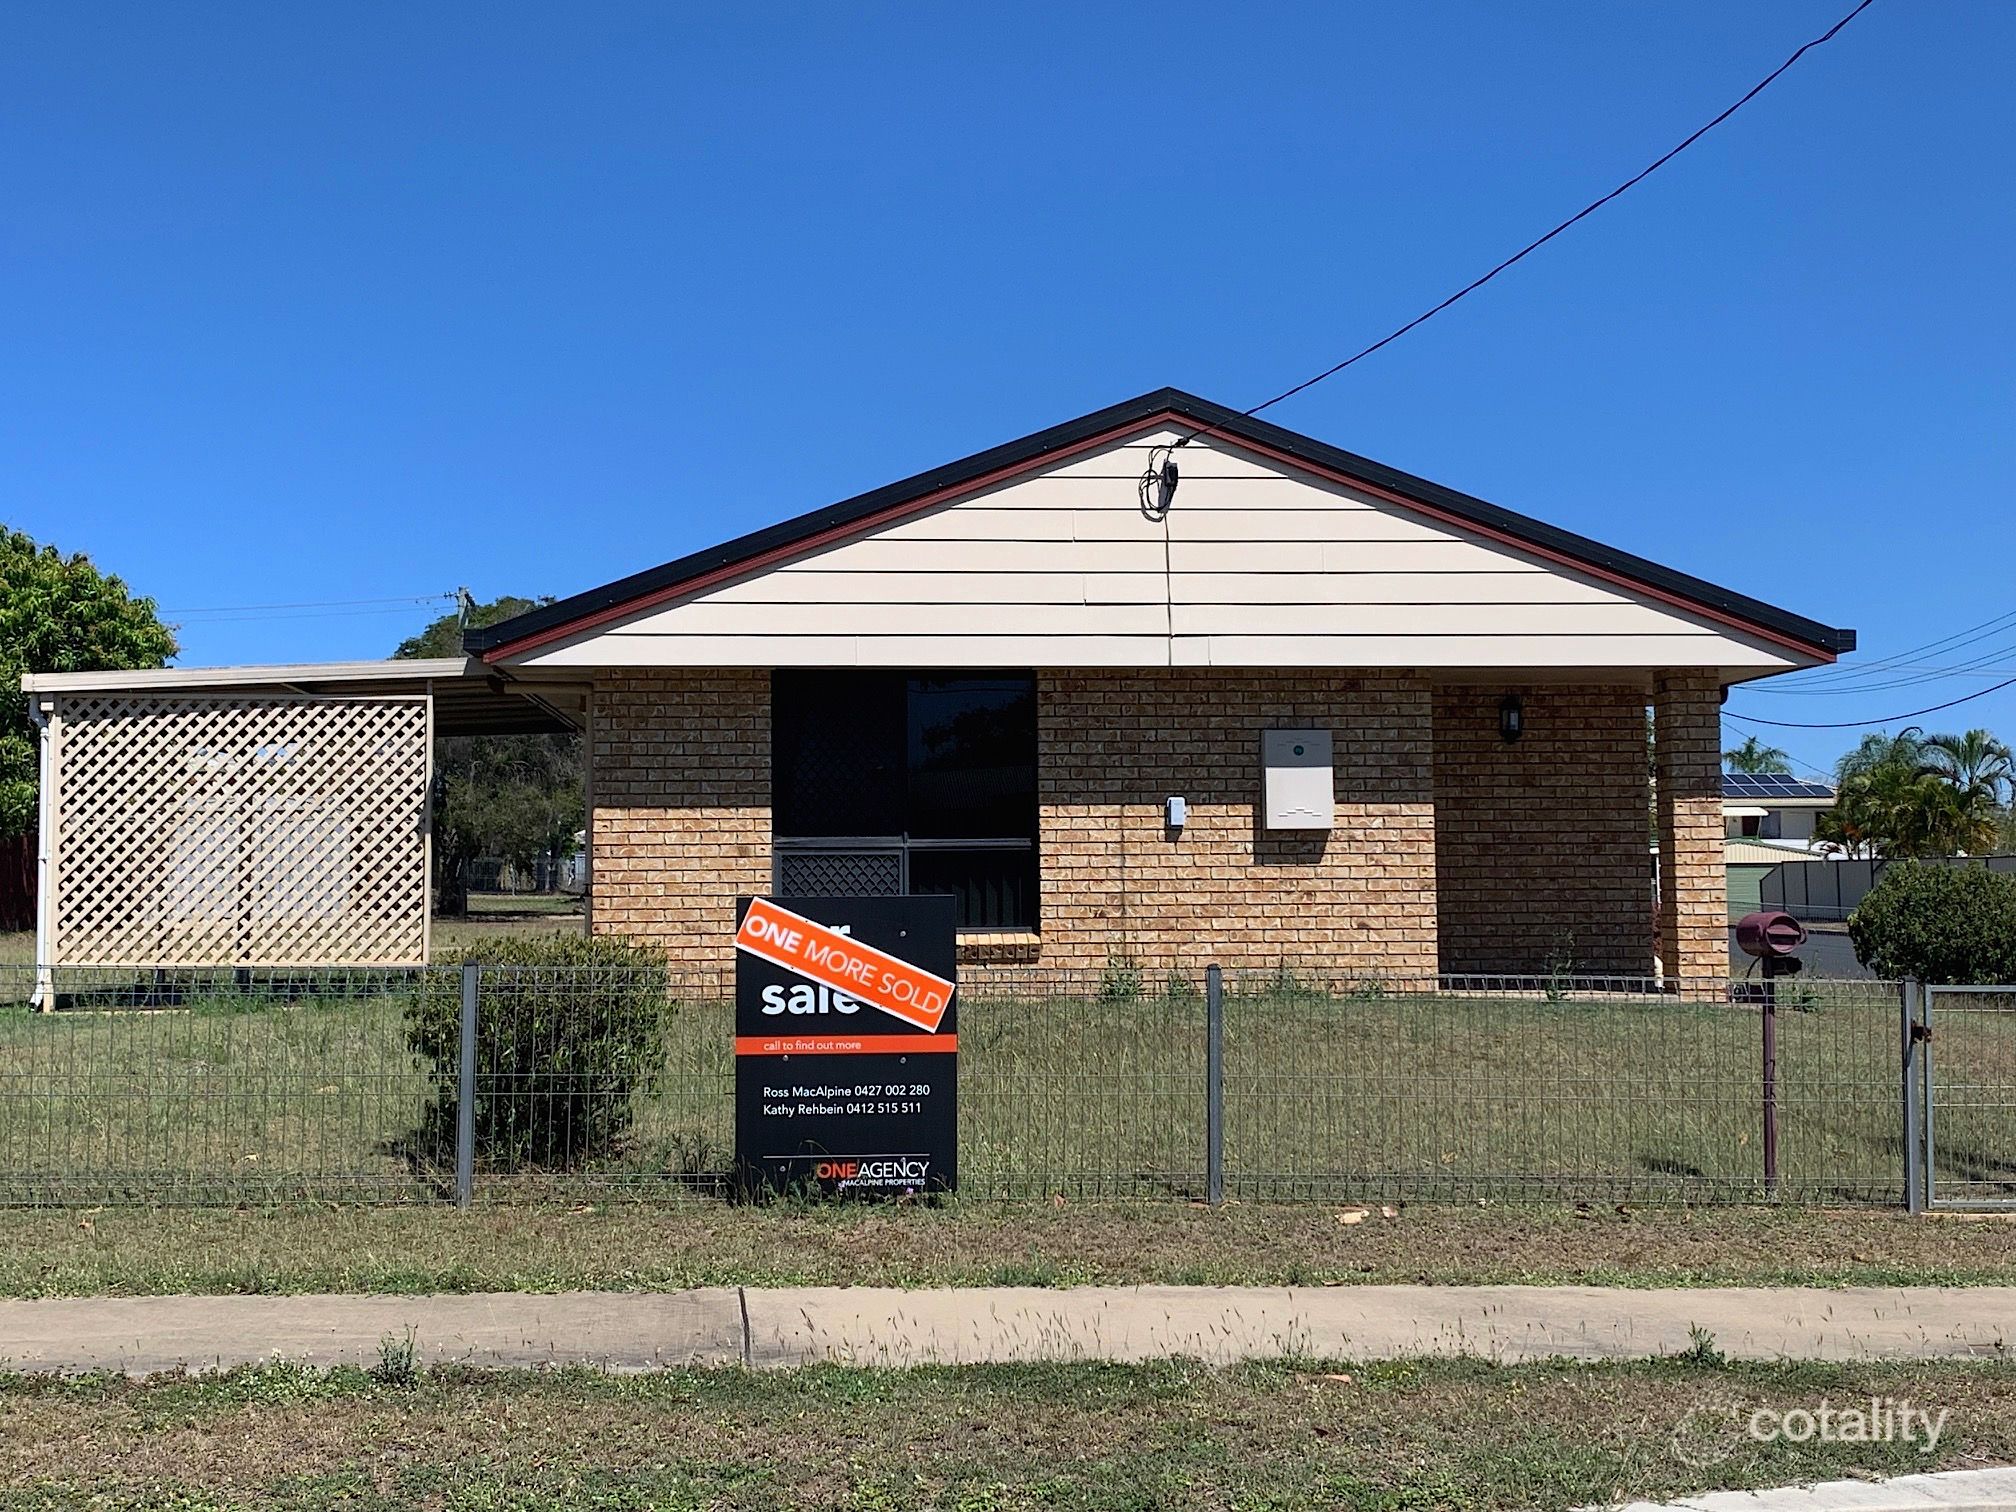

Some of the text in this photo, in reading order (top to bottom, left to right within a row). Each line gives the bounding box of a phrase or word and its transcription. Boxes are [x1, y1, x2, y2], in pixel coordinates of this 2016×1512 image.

[745, 915, 943, 1014] ONE MORE SOLD
[761, 984, 860, 1015] sale
[764, 1040, 780, 1050] call
[782, 1041, 793, 1050] to
[795, 1040, 815, 1050] find
[817, 1041, 833, 1050] out
[763, 1084, 930, 1099] Ross MacAlpine 0427 002 280
[763, 1102, 921, 1117] Kathy Rehbein 0412 515 511
[885, 1178, 925, 1186] PROPERTIES
